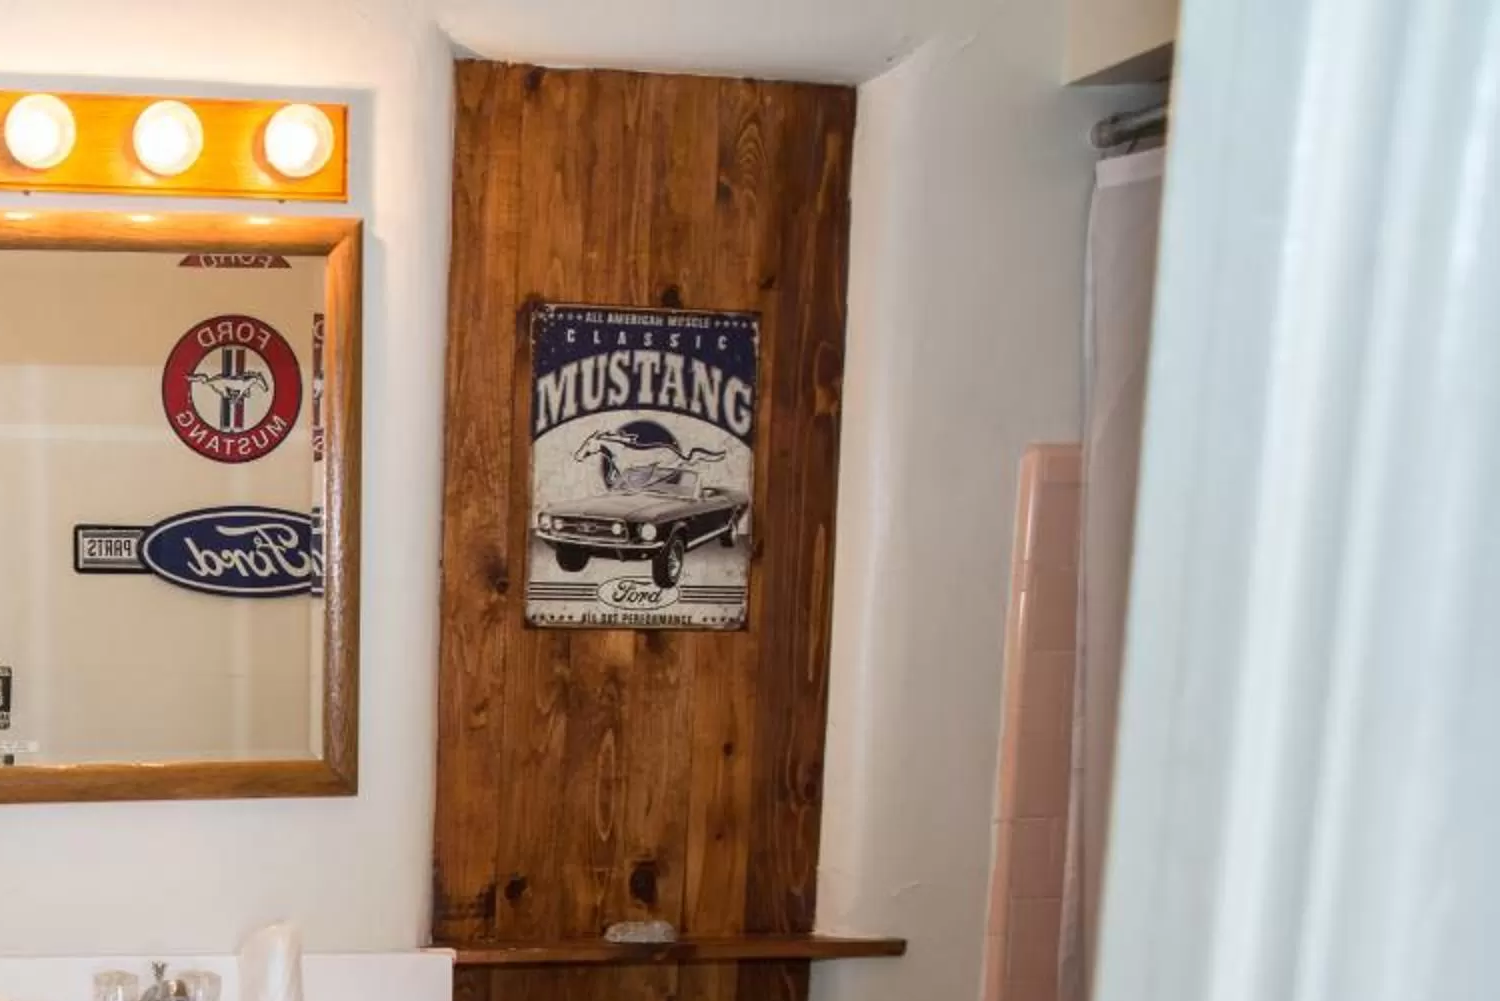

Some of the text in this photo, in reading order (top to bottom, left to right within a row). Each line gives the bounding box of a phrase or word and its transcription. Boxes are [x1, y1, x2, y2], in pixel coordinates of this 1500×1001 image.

[585, 311, 712, 329] ALL AMERICAN MUSCLE
[566, 328, 729, 350] CLASSIC
[536, 350, 752, 436] MUSTANG
[612, 579, 663, 605] Ford
